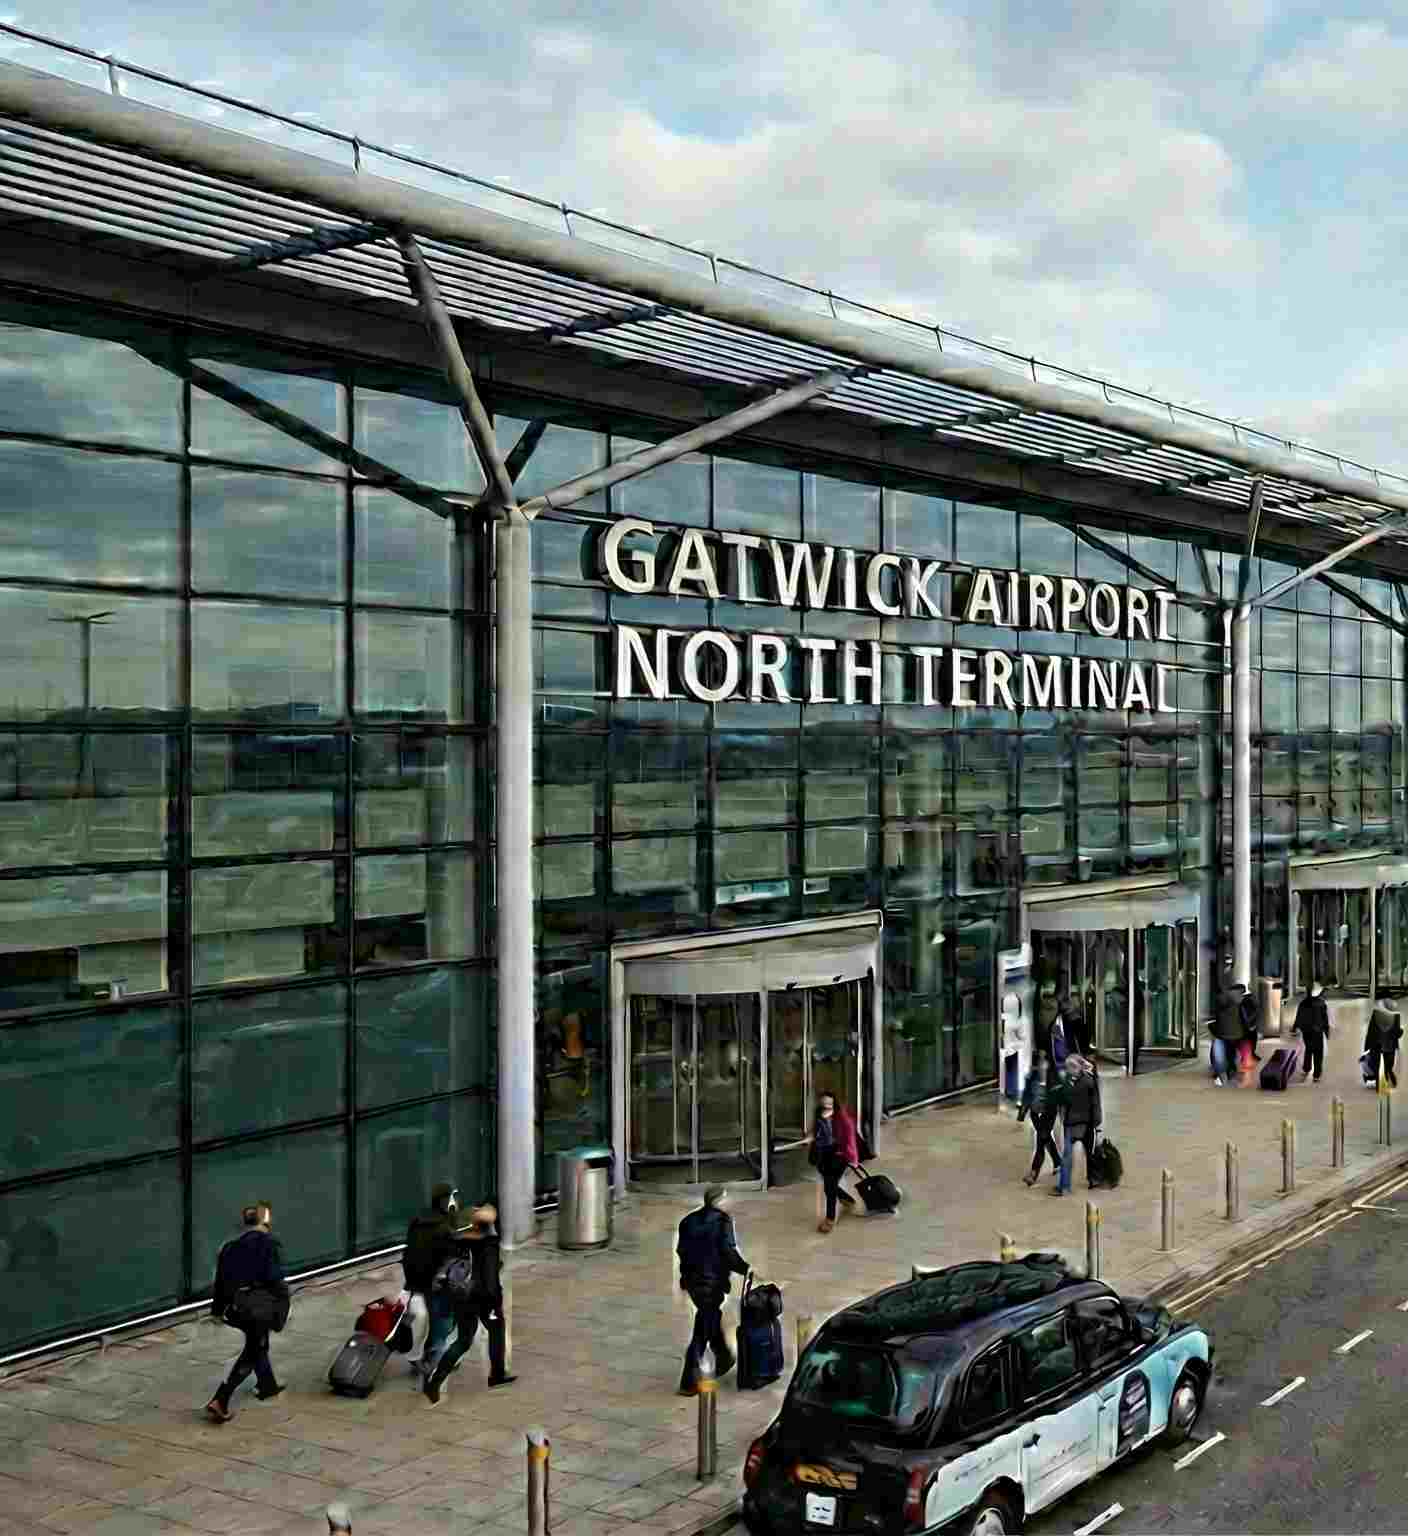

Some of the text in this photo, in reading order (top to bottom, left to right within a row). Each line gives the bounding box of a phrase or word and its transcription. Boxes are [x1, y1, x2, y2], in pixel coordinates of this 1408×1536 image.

[604, 518, 1177, 641] GATWICK AIRPORT
[616, 625, 1177, 712] NORTH TERMINAL
